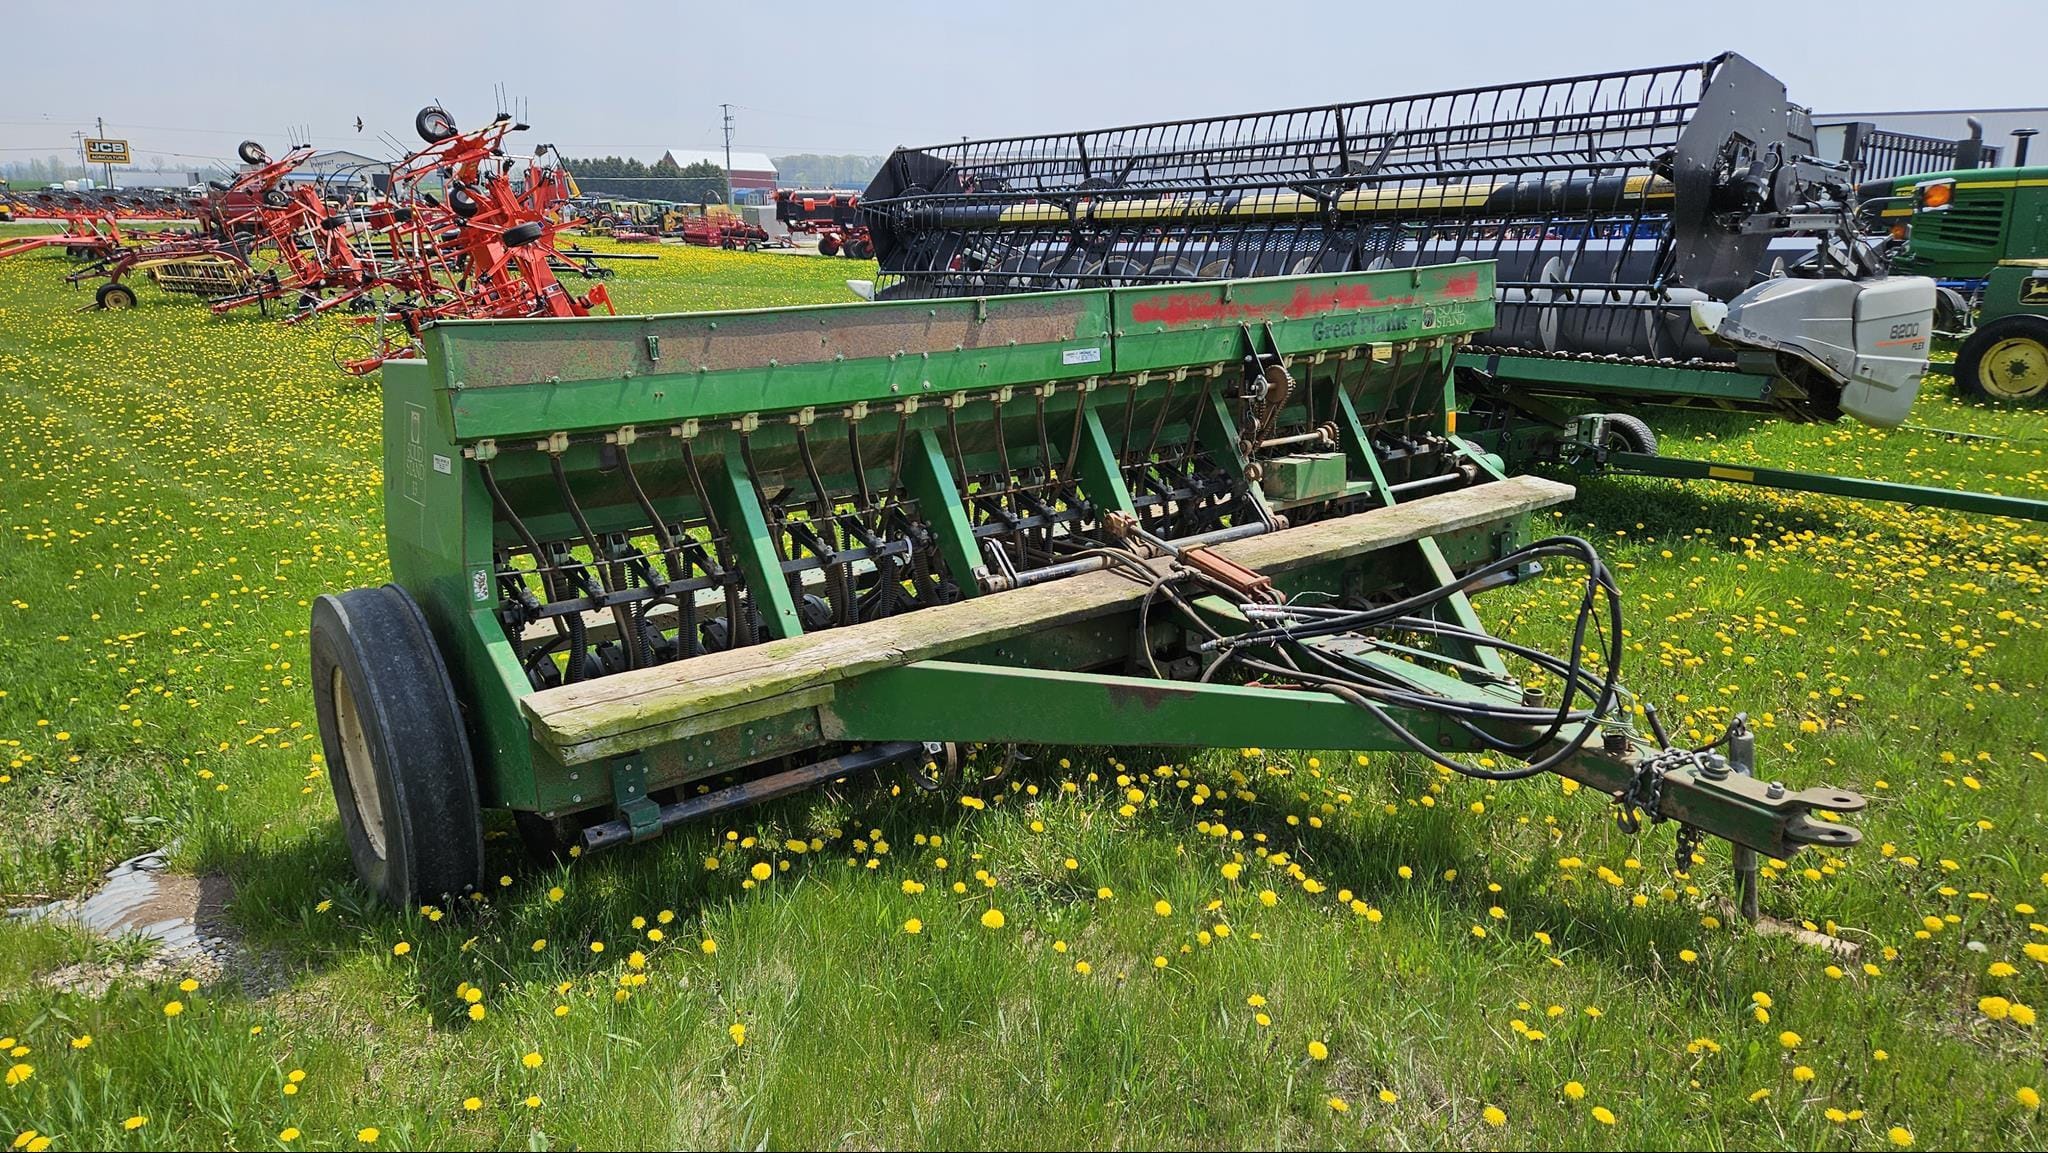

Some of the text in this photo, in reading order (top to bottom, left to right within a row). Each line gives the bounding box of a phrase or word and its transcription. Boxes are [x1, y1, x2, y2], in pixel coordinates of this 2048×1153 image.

[90, 142, 125, 153] JCB
[1311, 314, 1409, 342] Great Plains
[1436, 313, 1466, 328] STAND
[1889, 322, 1919, 339] 8200
[1911, 341, 1925, 350] FLEX
